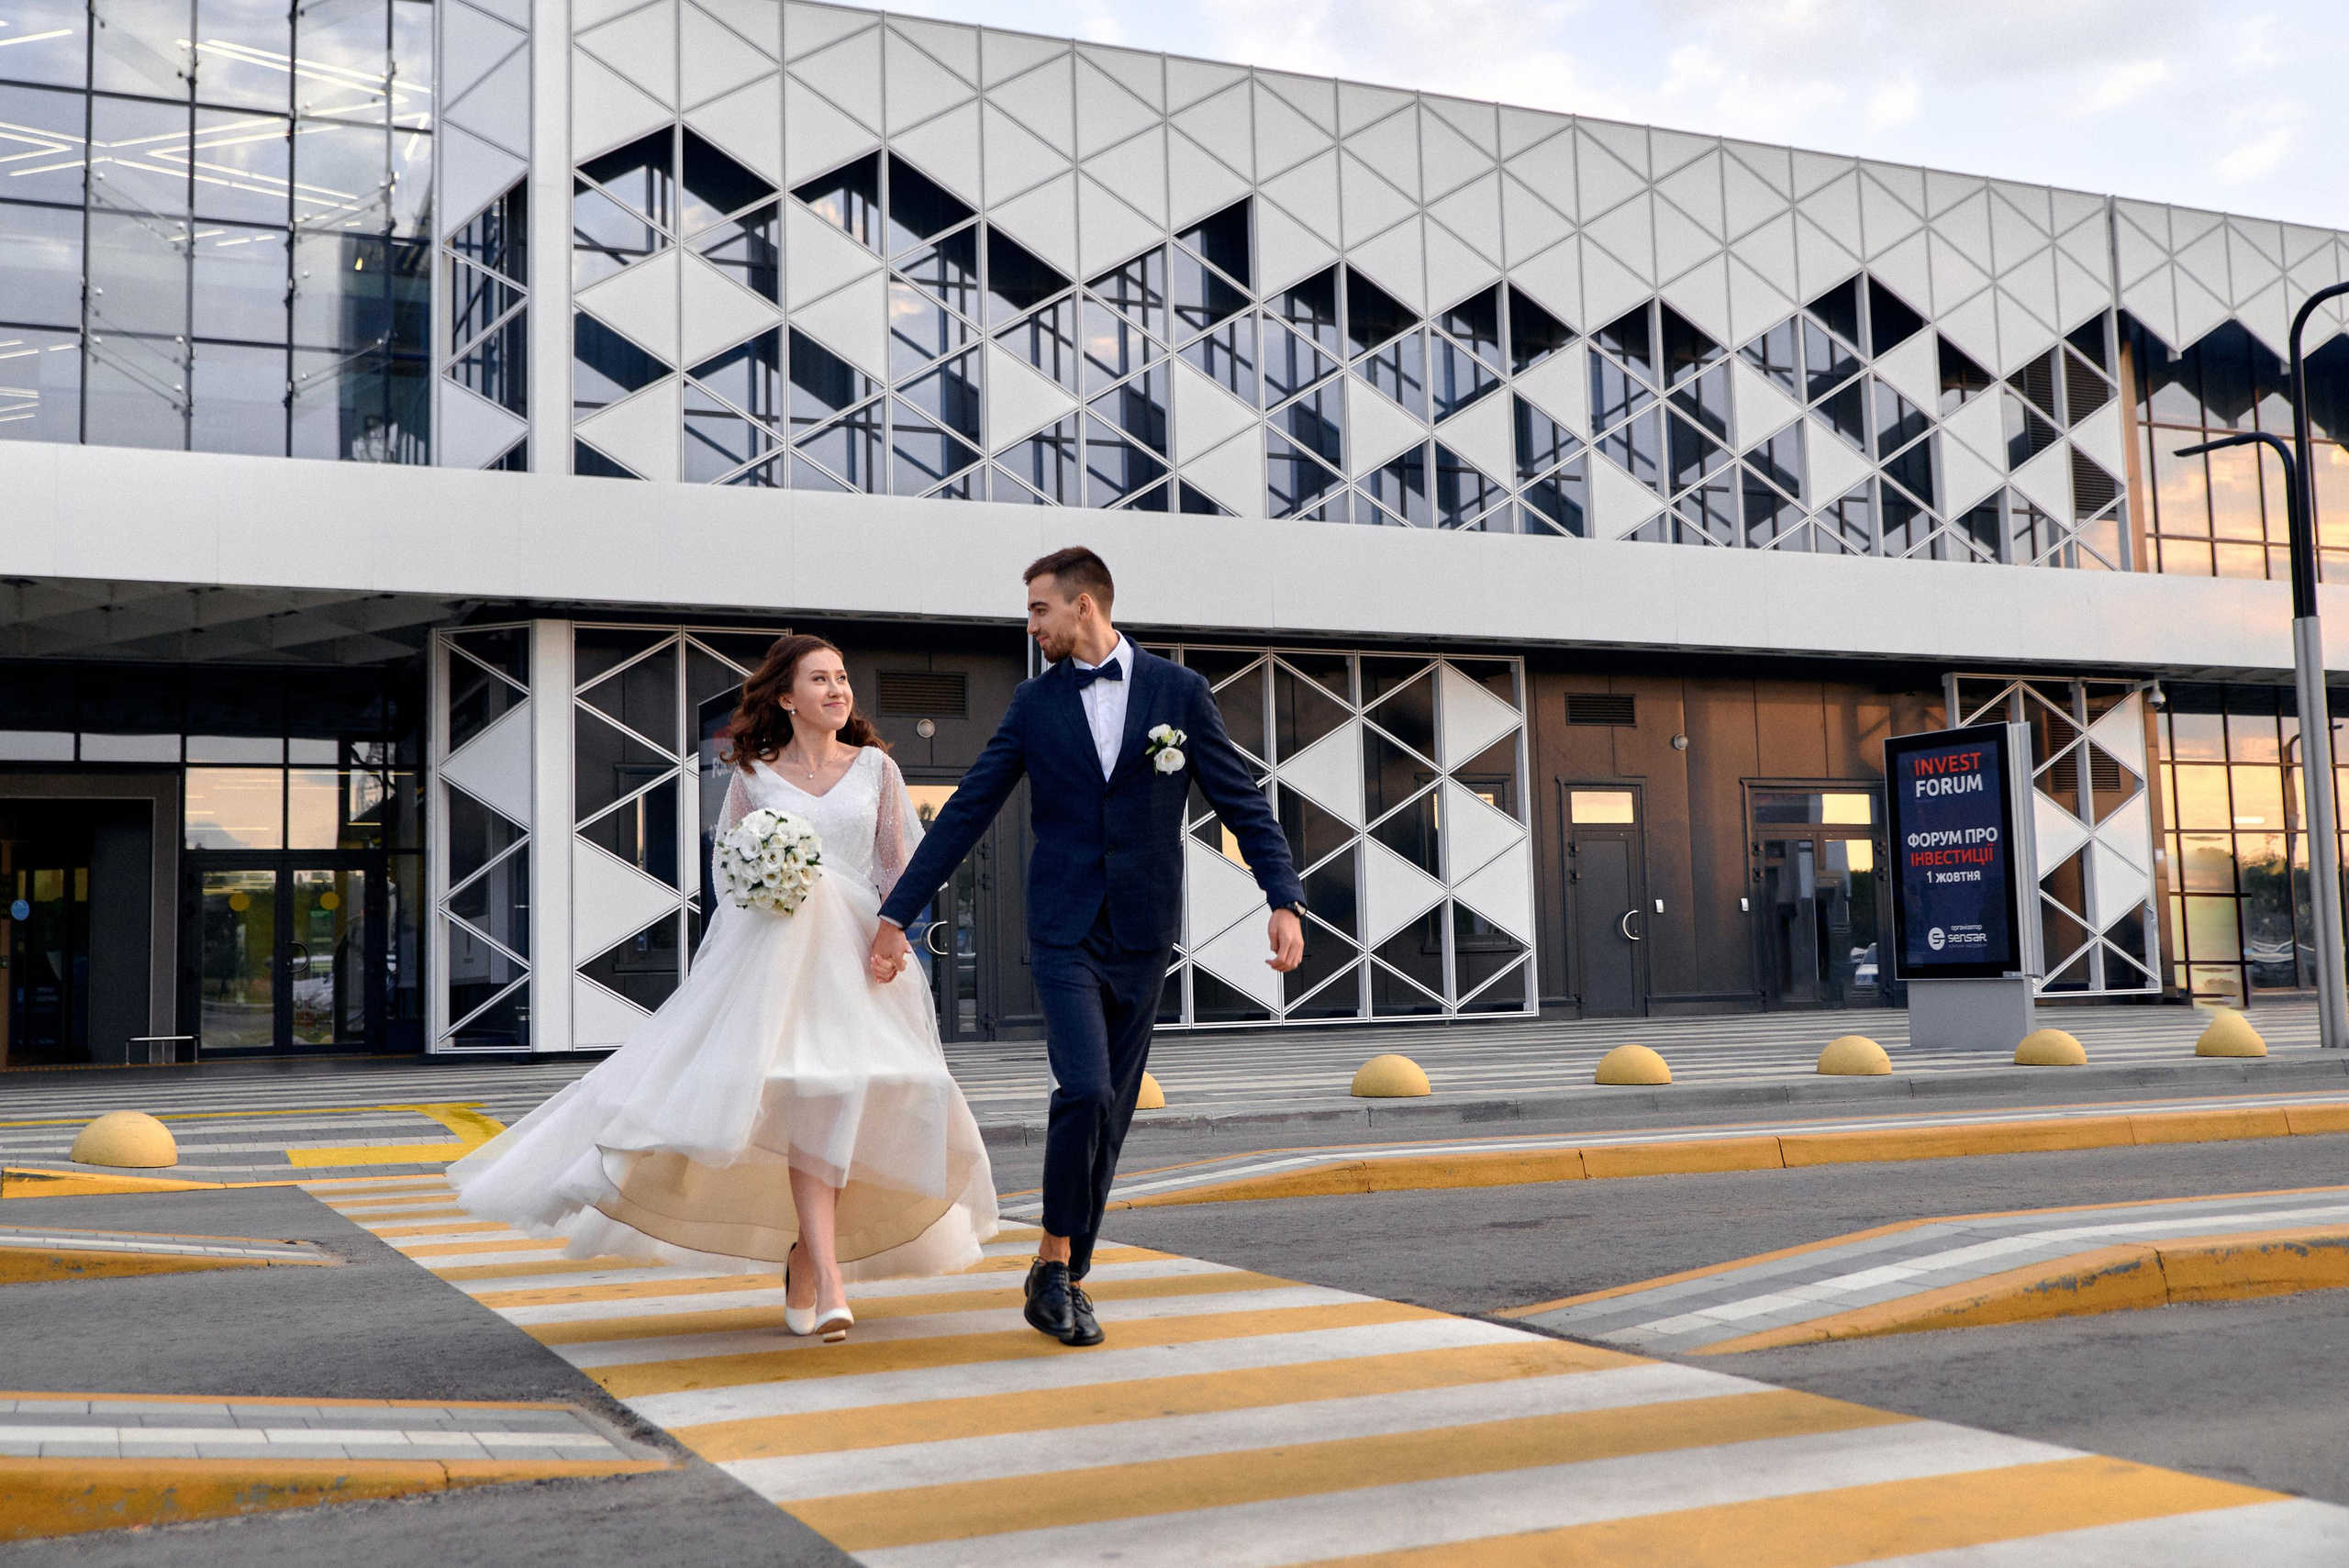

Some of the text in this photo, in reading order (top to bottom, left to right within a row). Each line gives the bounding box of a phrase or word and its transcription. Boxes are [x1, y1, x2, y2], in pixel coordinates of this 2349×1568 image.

[1914, 752, 1982, 776] INVEST
[1916, 773, 1983, 797] FORUM
[1908, 827, 1998, 848] ФОРУМ ПРО
[1910, 843, 1994, 867] ІНВЕСТИЦІЇ
[1926, 871, 1932, 884] 1
